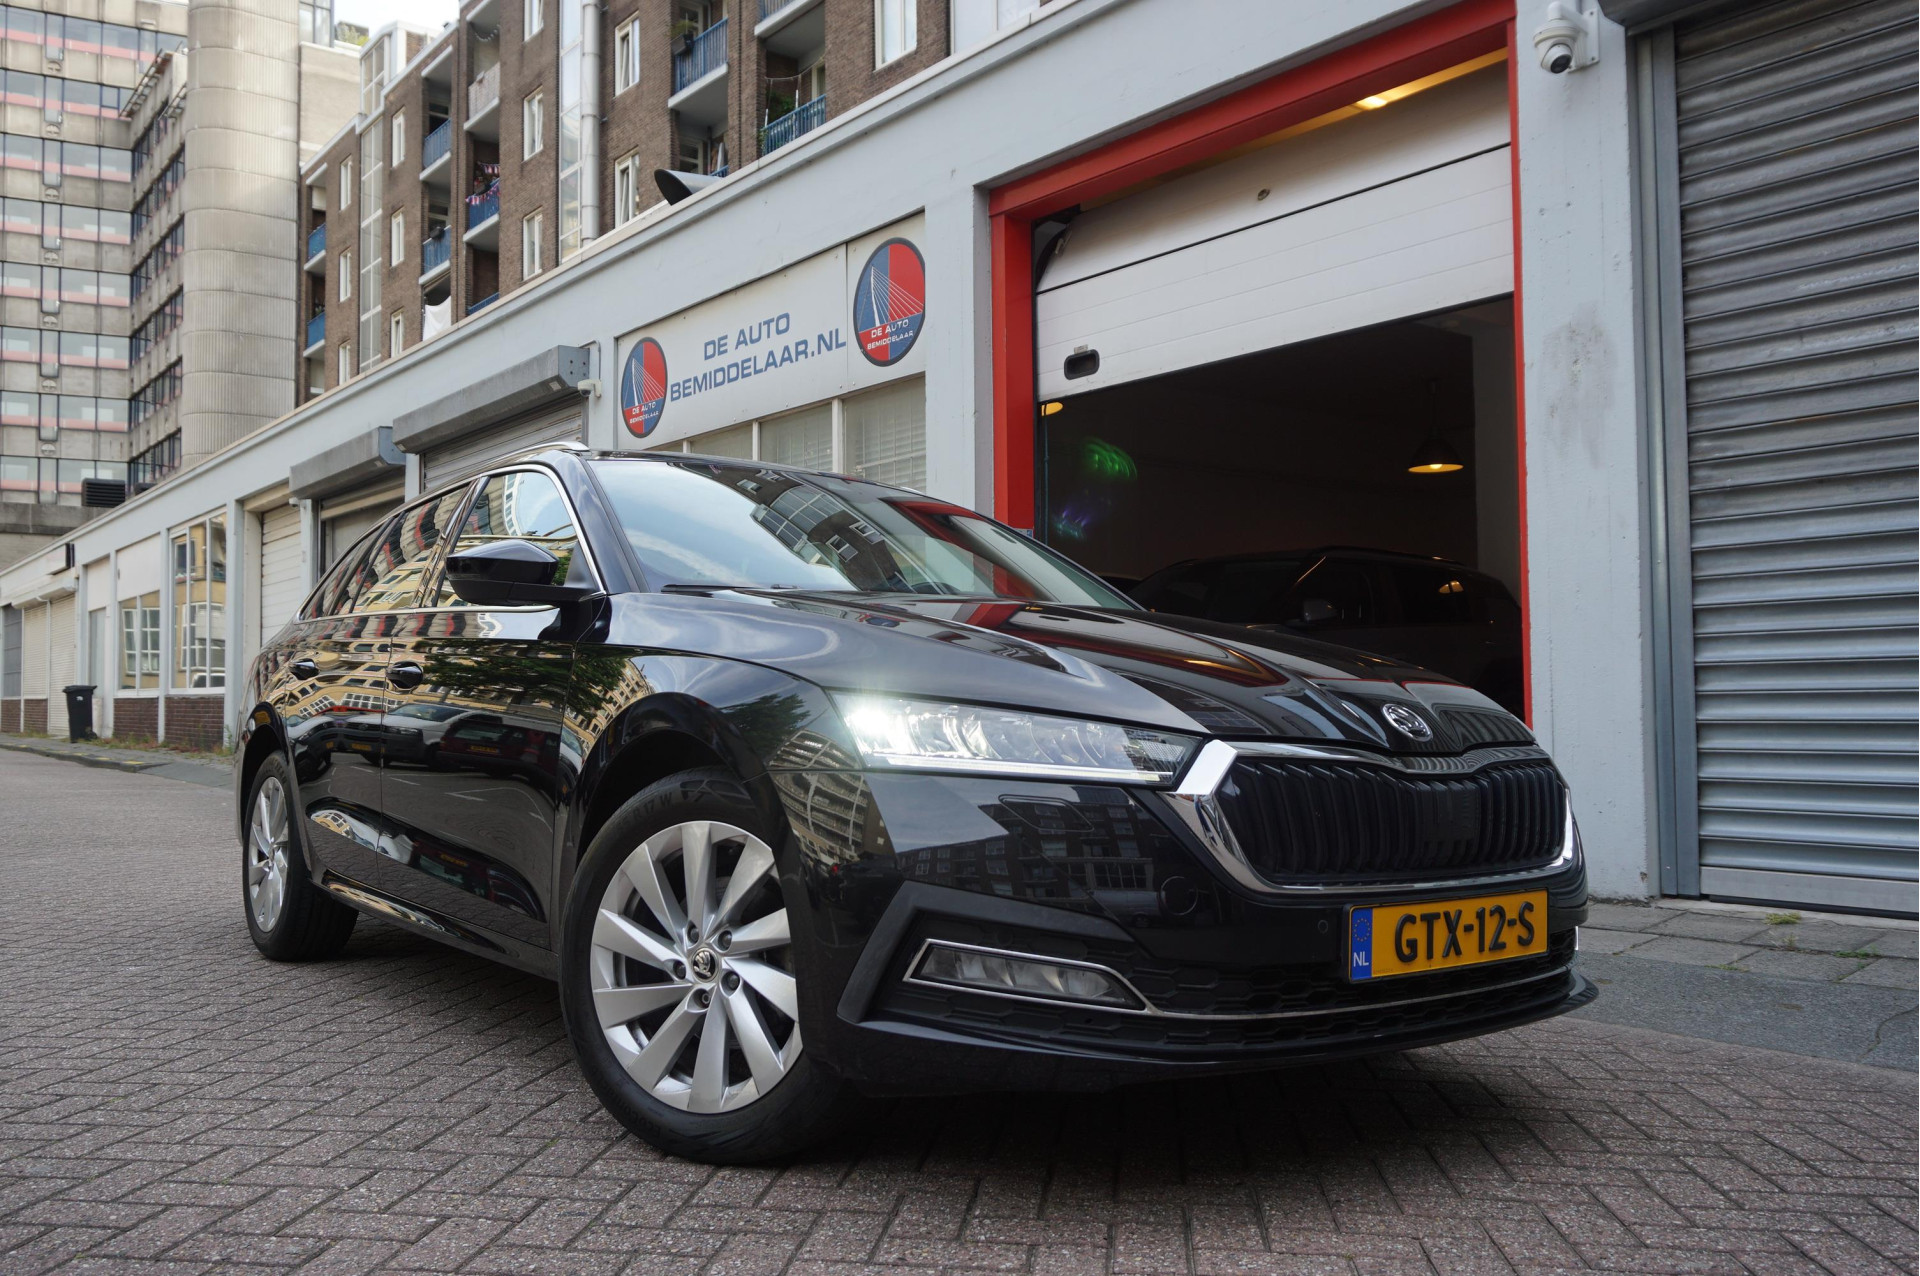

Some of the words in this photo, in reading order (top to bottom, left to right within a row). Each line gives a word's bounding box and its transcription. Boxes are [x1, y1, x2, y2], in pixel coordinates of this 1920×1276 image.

[704, 334, 728, 361] DE
[735, 312, 790, 350] AUTO
[871, 327, 883, 338] DE
[885, 319, 909, 334] AUTO
[867, 330, 914, 350] BEMIDDELAAR
[670, 328, 847, 402] BEMIDDELAAR.NL
[632, 406, 640, 415] DE
[641, 401, 657, 412] AUTO
[1394, 901, 1535, 963] GTX-12-S
[1353, 951, 1369, 967] NL
